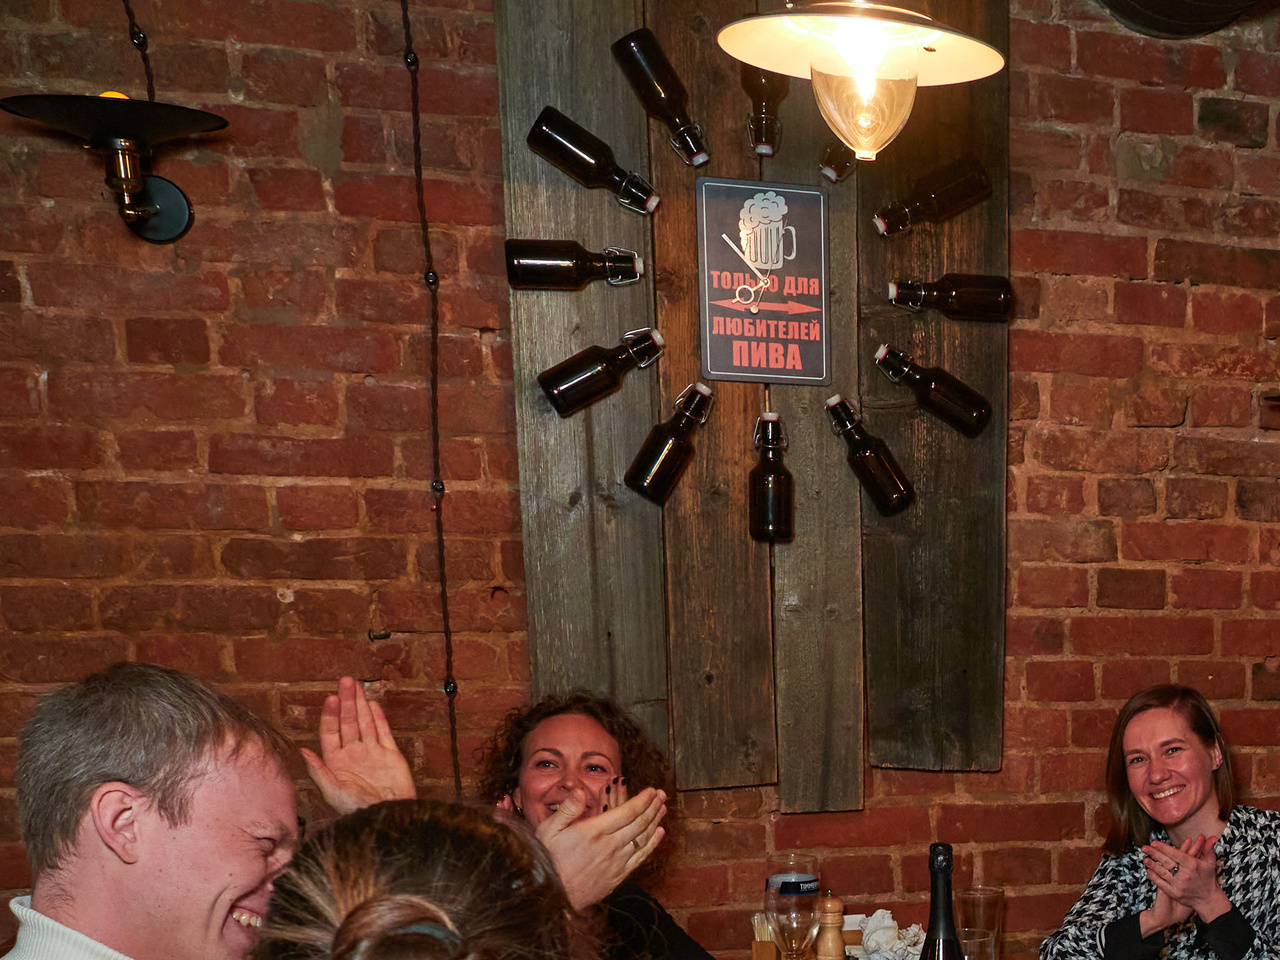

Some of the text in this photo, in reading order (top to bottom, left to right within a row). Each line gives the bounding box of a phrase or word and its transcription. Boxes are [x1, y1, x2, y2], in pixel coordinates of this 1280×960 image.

[710, 270, 820, 296] ТОЛЬО ДЛЯ
[712, 316, 821, 341] ЛЮБИТЕЛЕЙ
[732, 340, 803, 370] ПИВА
